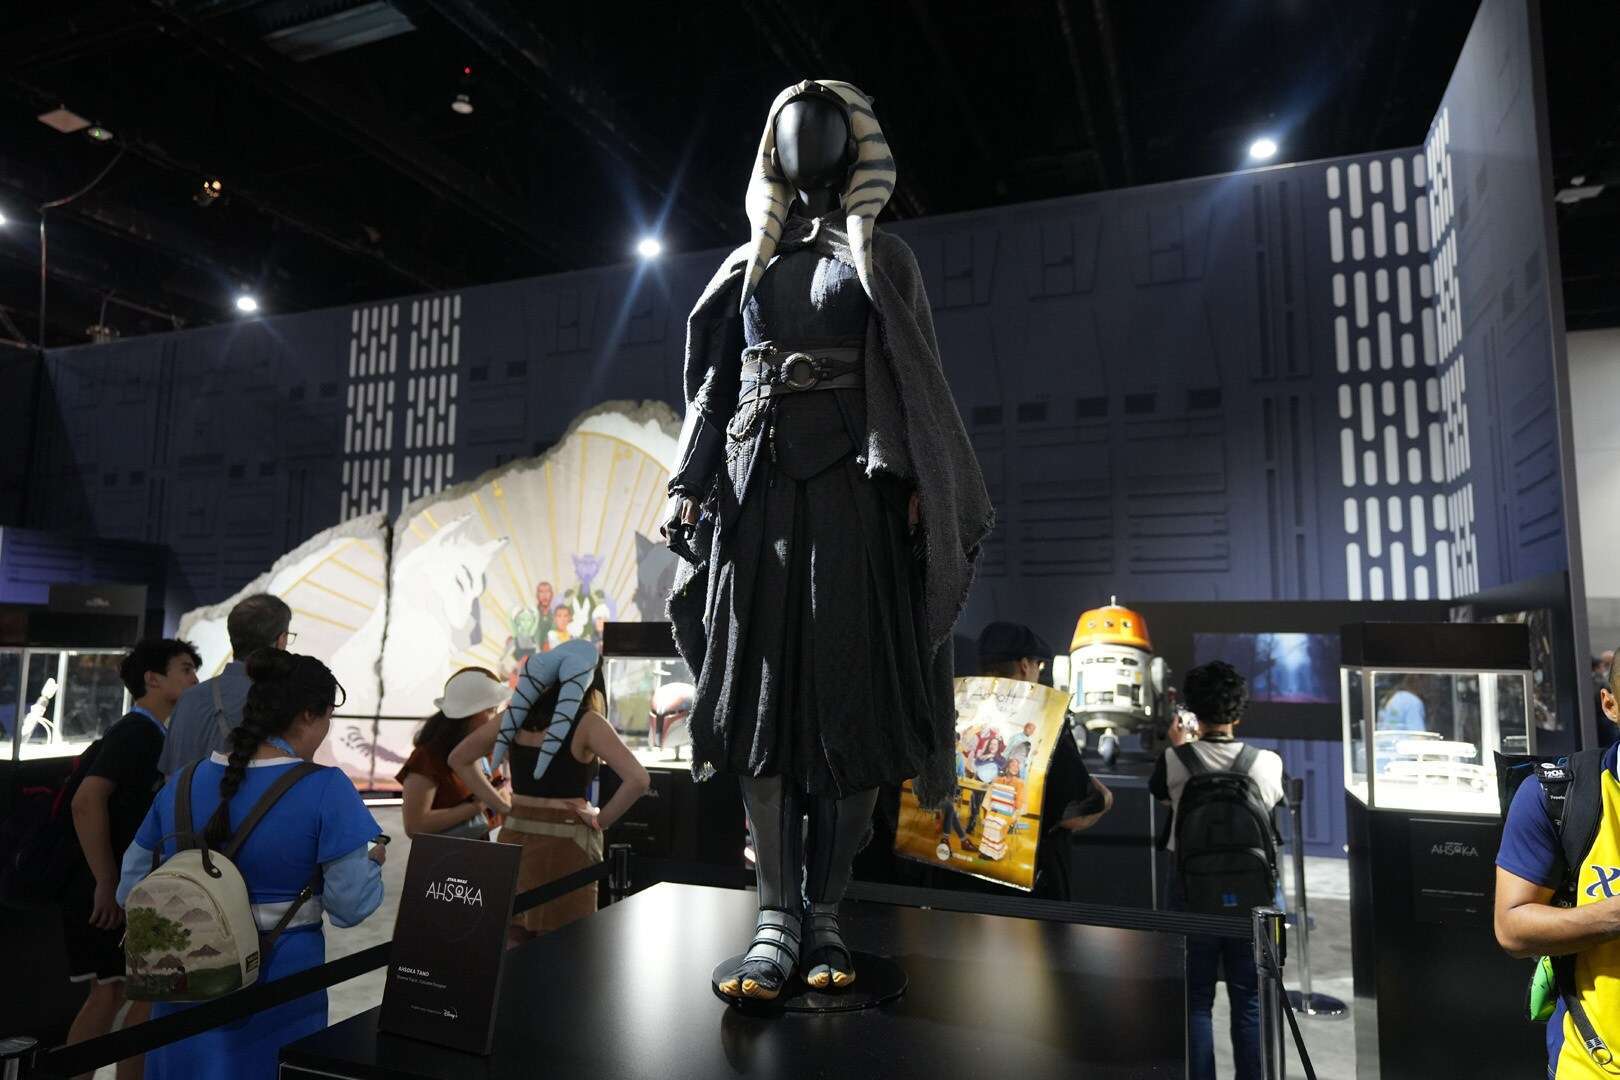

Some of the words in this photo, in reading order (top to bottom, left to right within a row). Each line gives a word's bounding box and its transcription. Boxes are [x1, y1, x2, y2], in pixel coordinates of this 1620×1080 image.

[1431, 845, 1478, 856] AHSOKA
[425, 881, 483, 907] AHSOKA
[398, 966, 416, 974] AHSOKA
[417, 969, 430, 977] TANO
